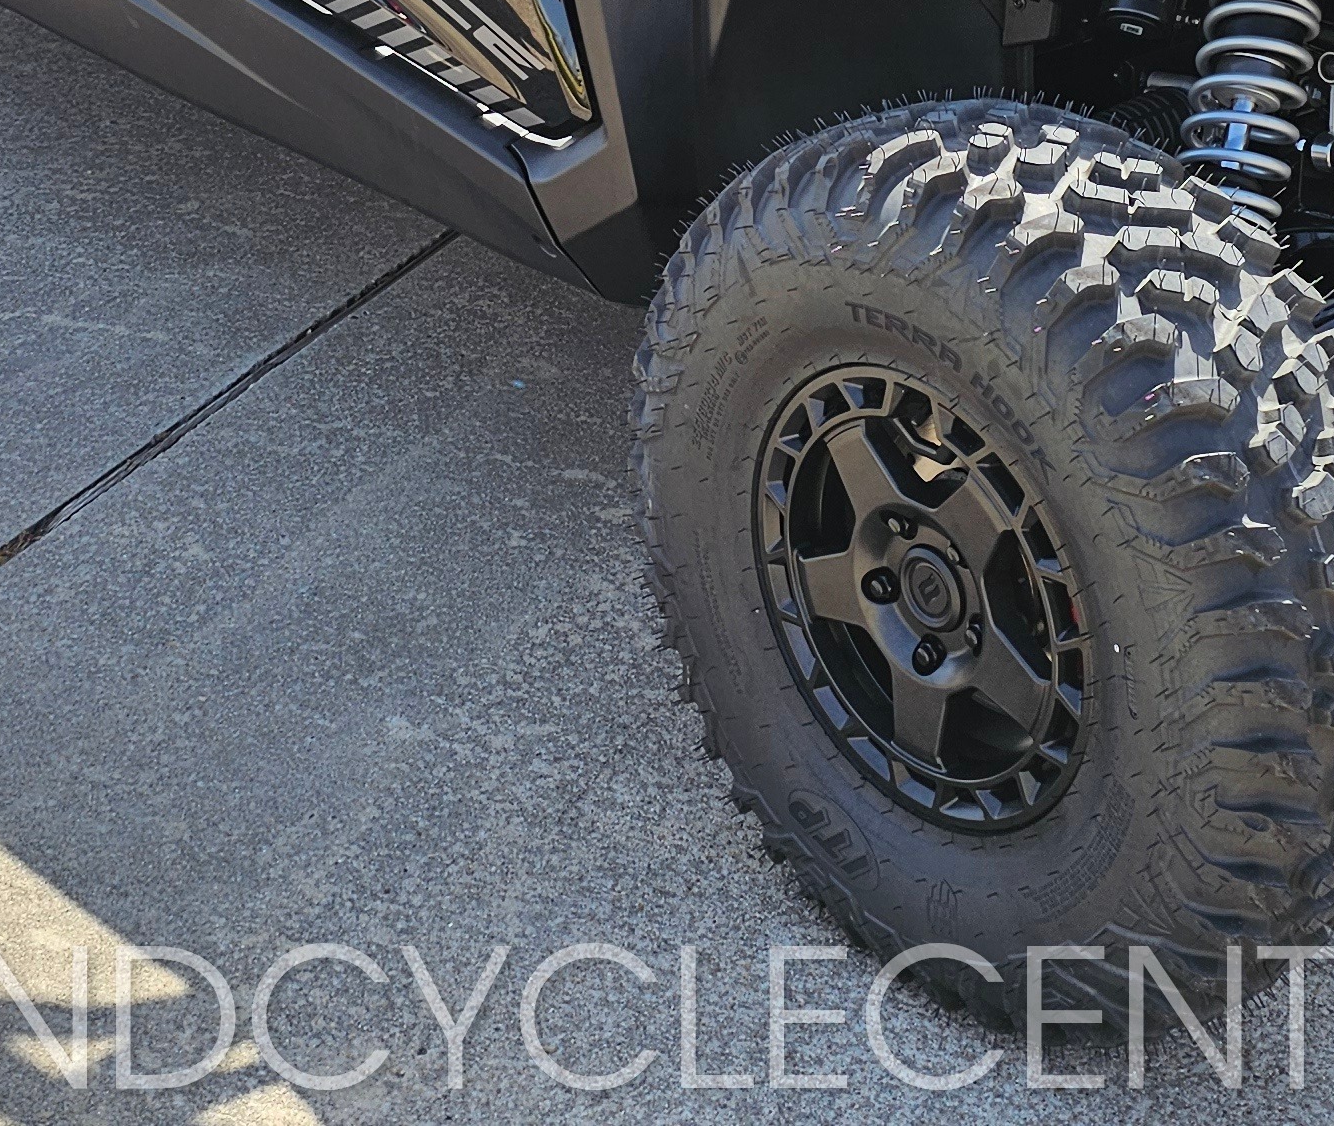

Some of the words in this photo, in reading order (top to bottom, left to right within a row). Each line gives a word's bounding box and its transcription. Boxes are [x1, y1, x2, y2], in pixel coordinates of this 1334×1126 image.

[845, 300, 963, 373] TERRA
[970, 371, 1058, 487] HOOK
[789, 800, 873, 880] ITP
